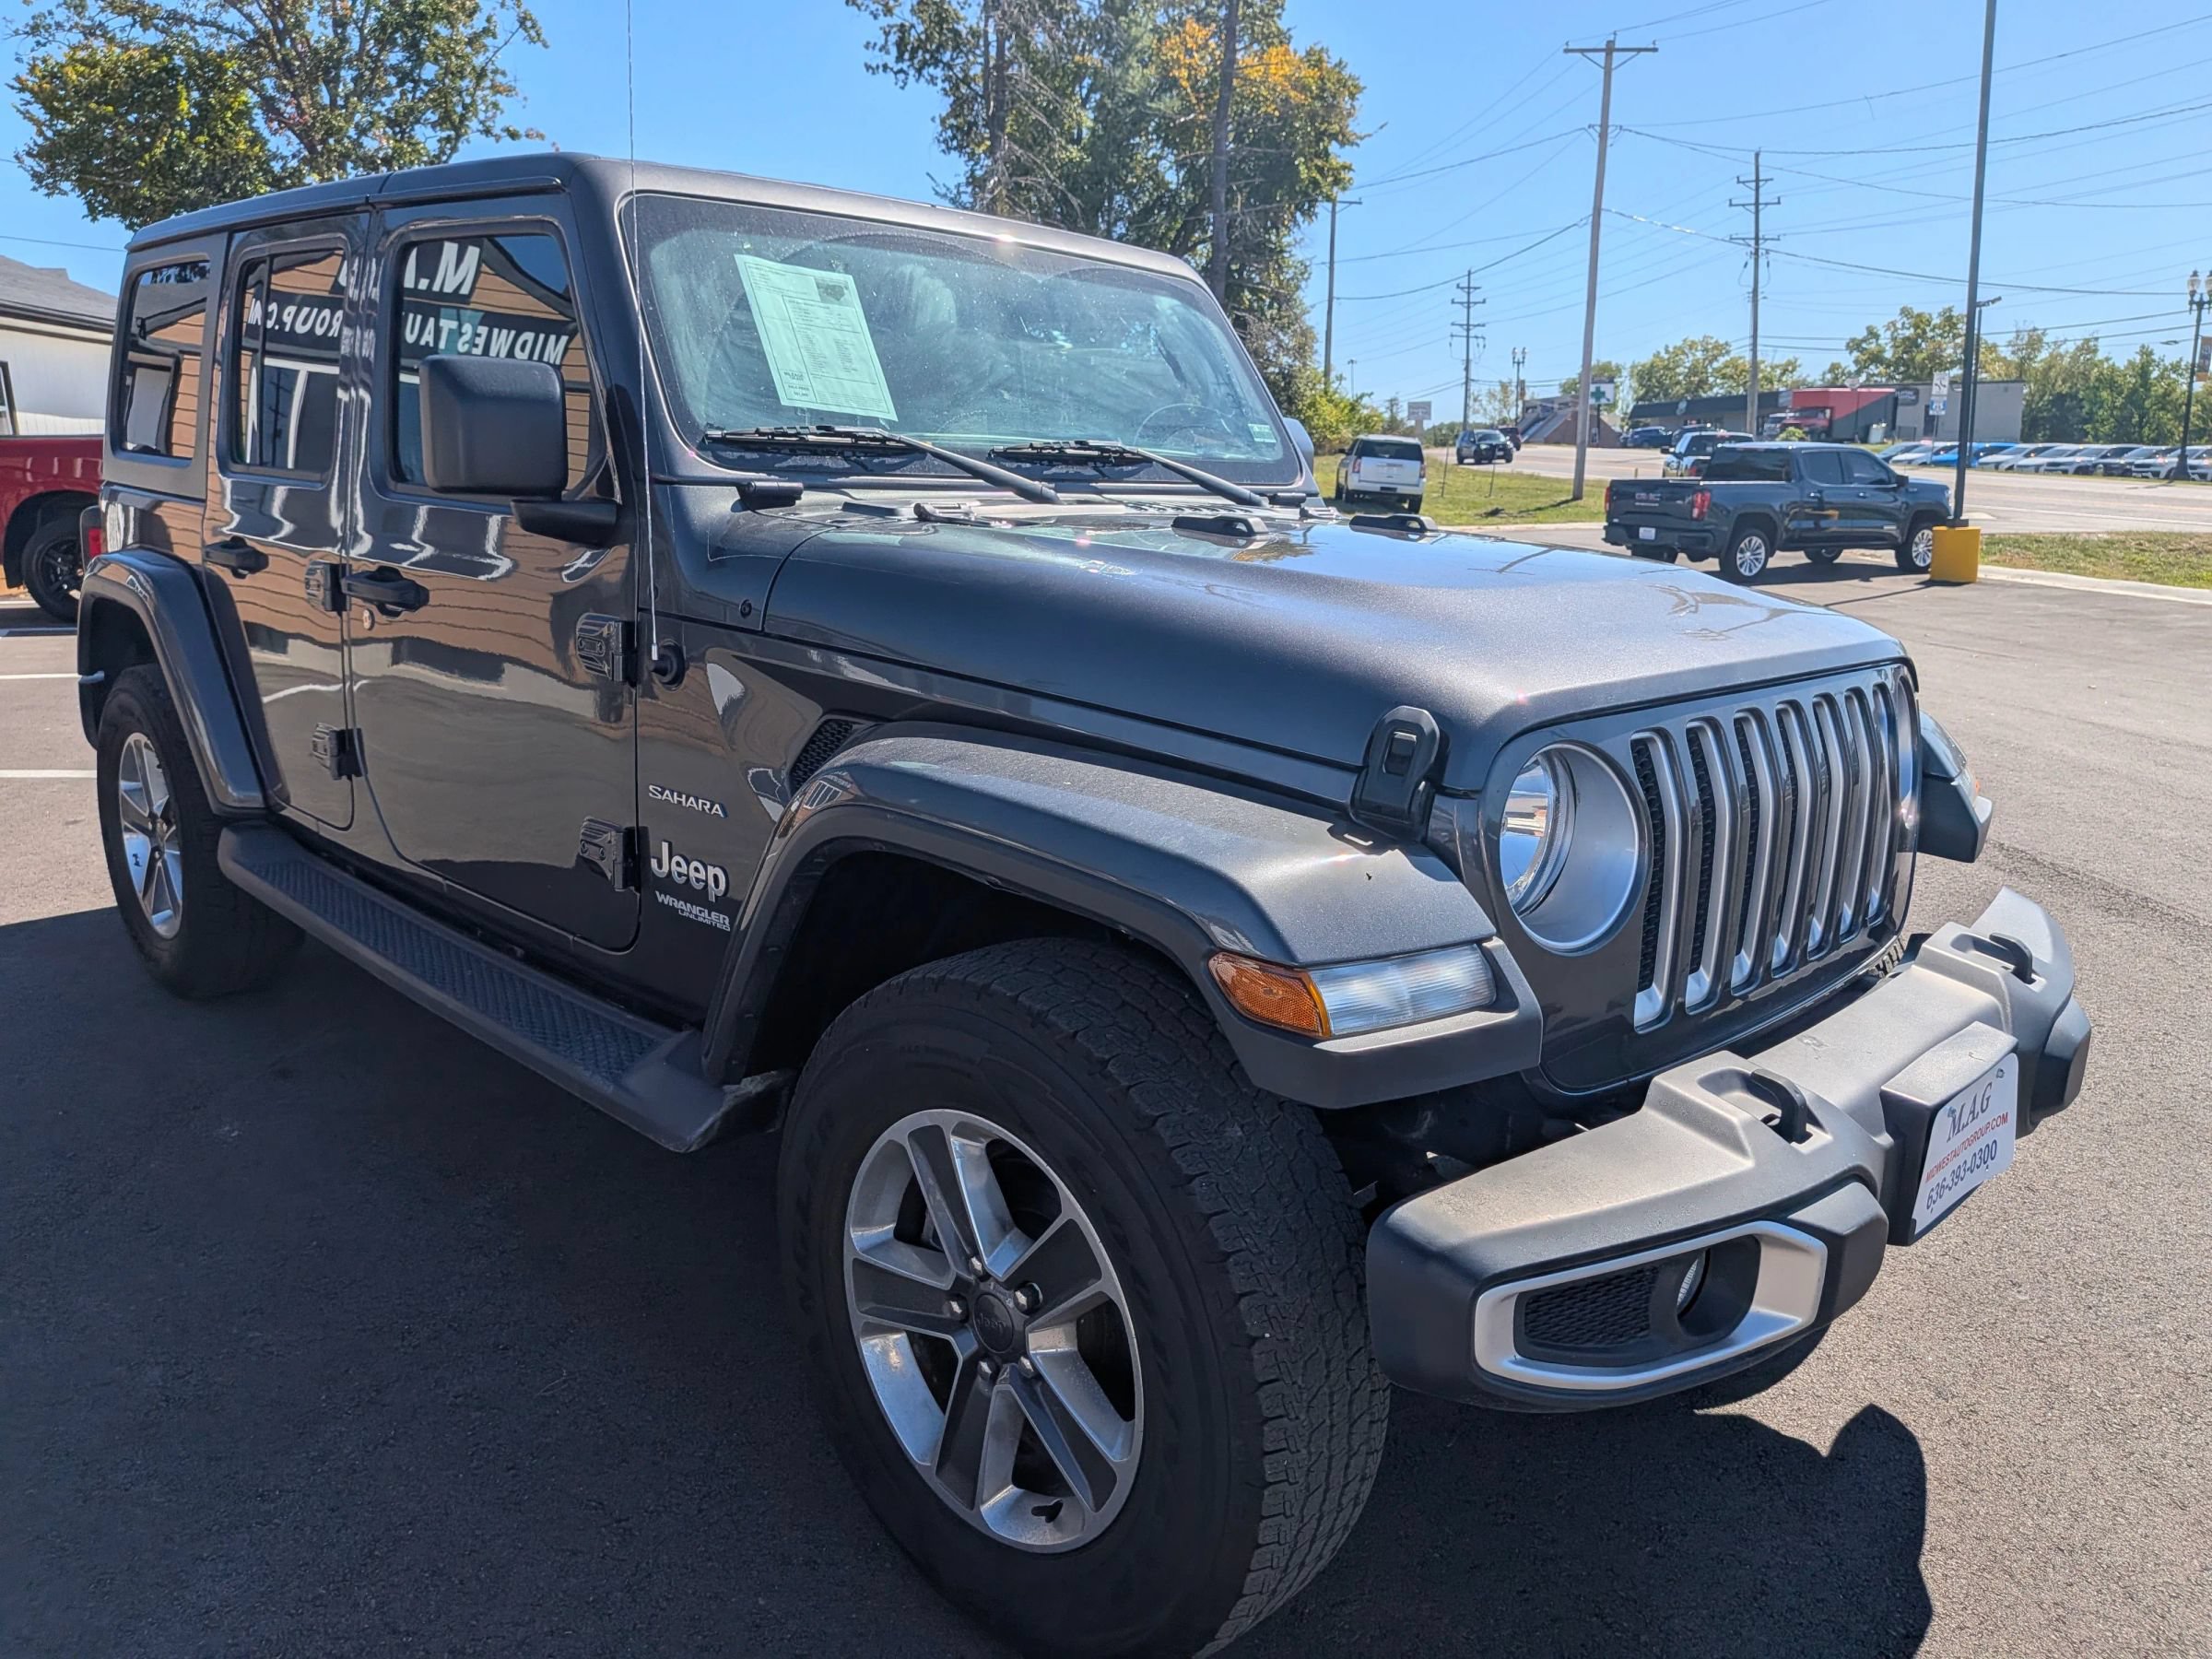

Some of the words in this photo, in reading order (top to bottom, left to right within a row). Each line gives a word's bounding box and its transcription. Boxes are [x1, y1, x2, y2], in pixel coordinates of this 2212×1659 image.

[648, 784, 727, 818] SAHARA
[651, 840, 729, 902] Jeep
[655, 890, 731, 926] WRANGLER
[678, 910, 731, 932] UNLIMITED
[1925, 1112, 2009, 1183] MIDWESTAUTOGROUP.COM
[1926, 1139, 1998, 1211] 636-393-0300
